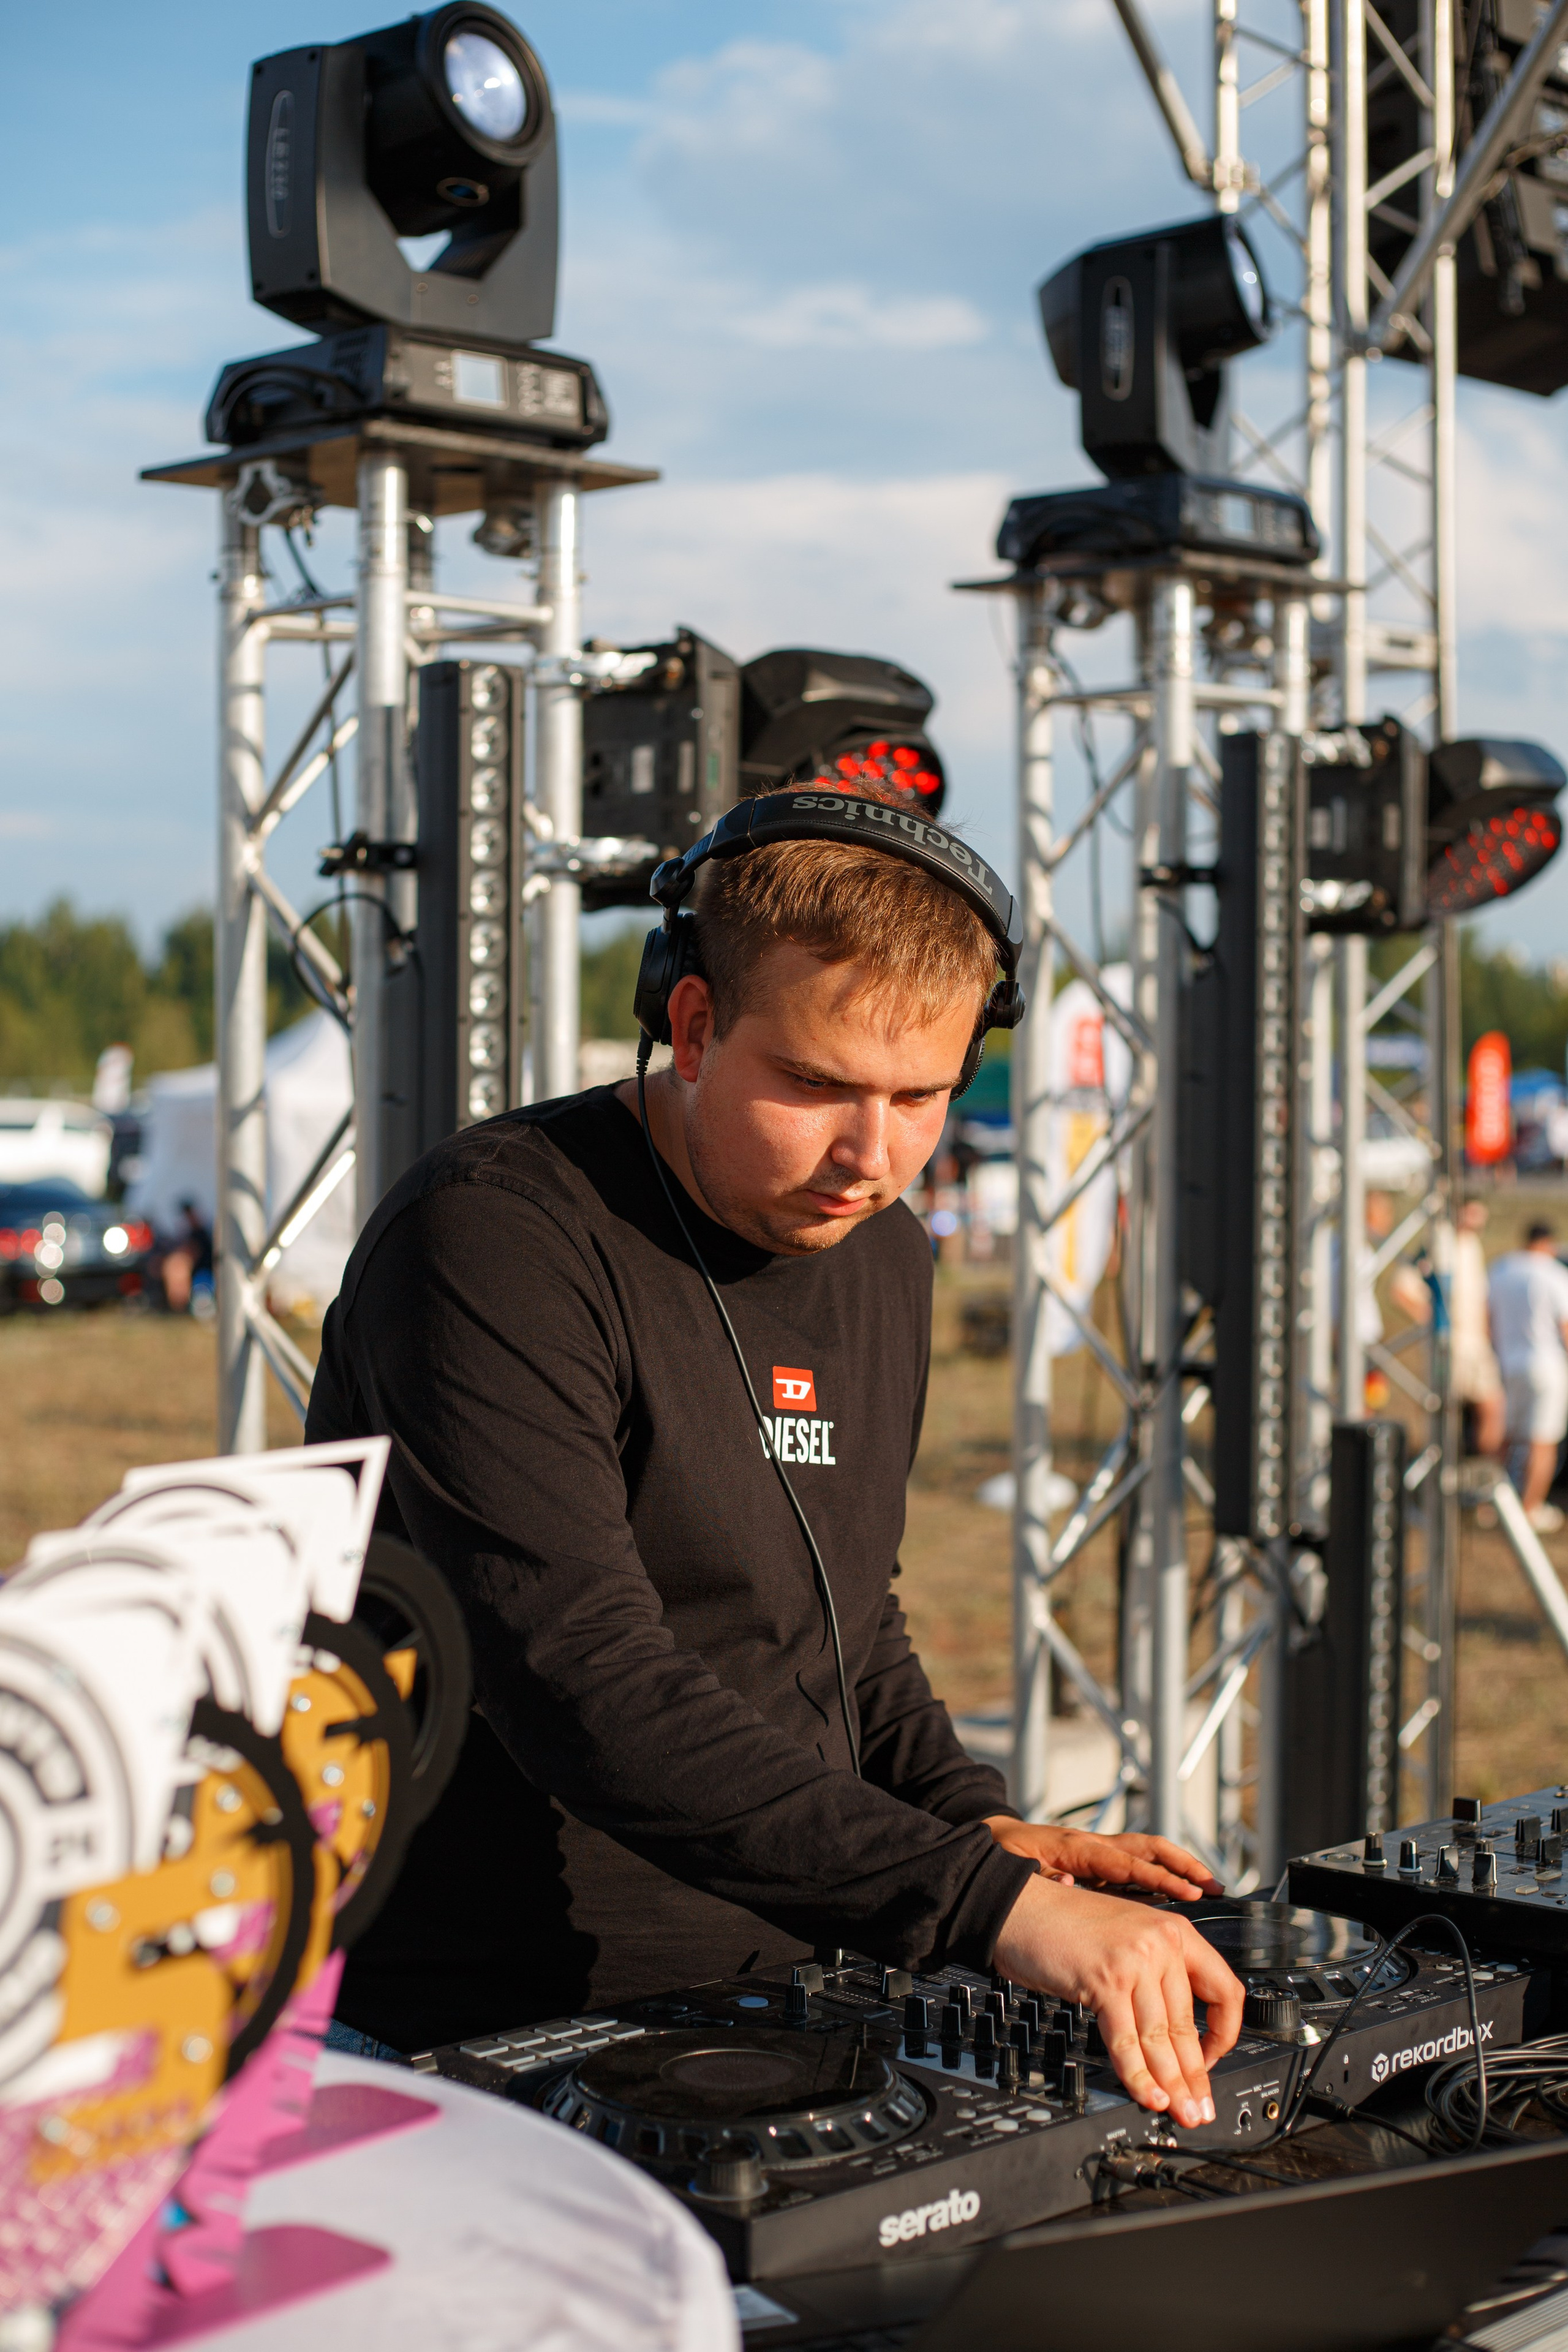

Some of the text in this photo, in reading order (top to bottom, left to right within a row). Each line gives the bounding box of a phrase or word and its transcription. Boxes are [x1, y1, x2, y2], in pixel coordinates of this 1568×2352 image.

[792, 796, 993, 895] Technics
[758, 1415, 836, 1465] DIESEL
[1369, 1956, 1385, 1979] COMPUTER
[1384, 1942, 1396, 1956] CABLE
[1395, 1929, 1411, 1943] VERSION
[1261, 2088, 1280, 2098] BALANCED
[1107, 2128, 1126, 2141] MASTER
[1152, 2116, 1168, 2127] BOOTH
[878, 2188, 981, 2248] serato
